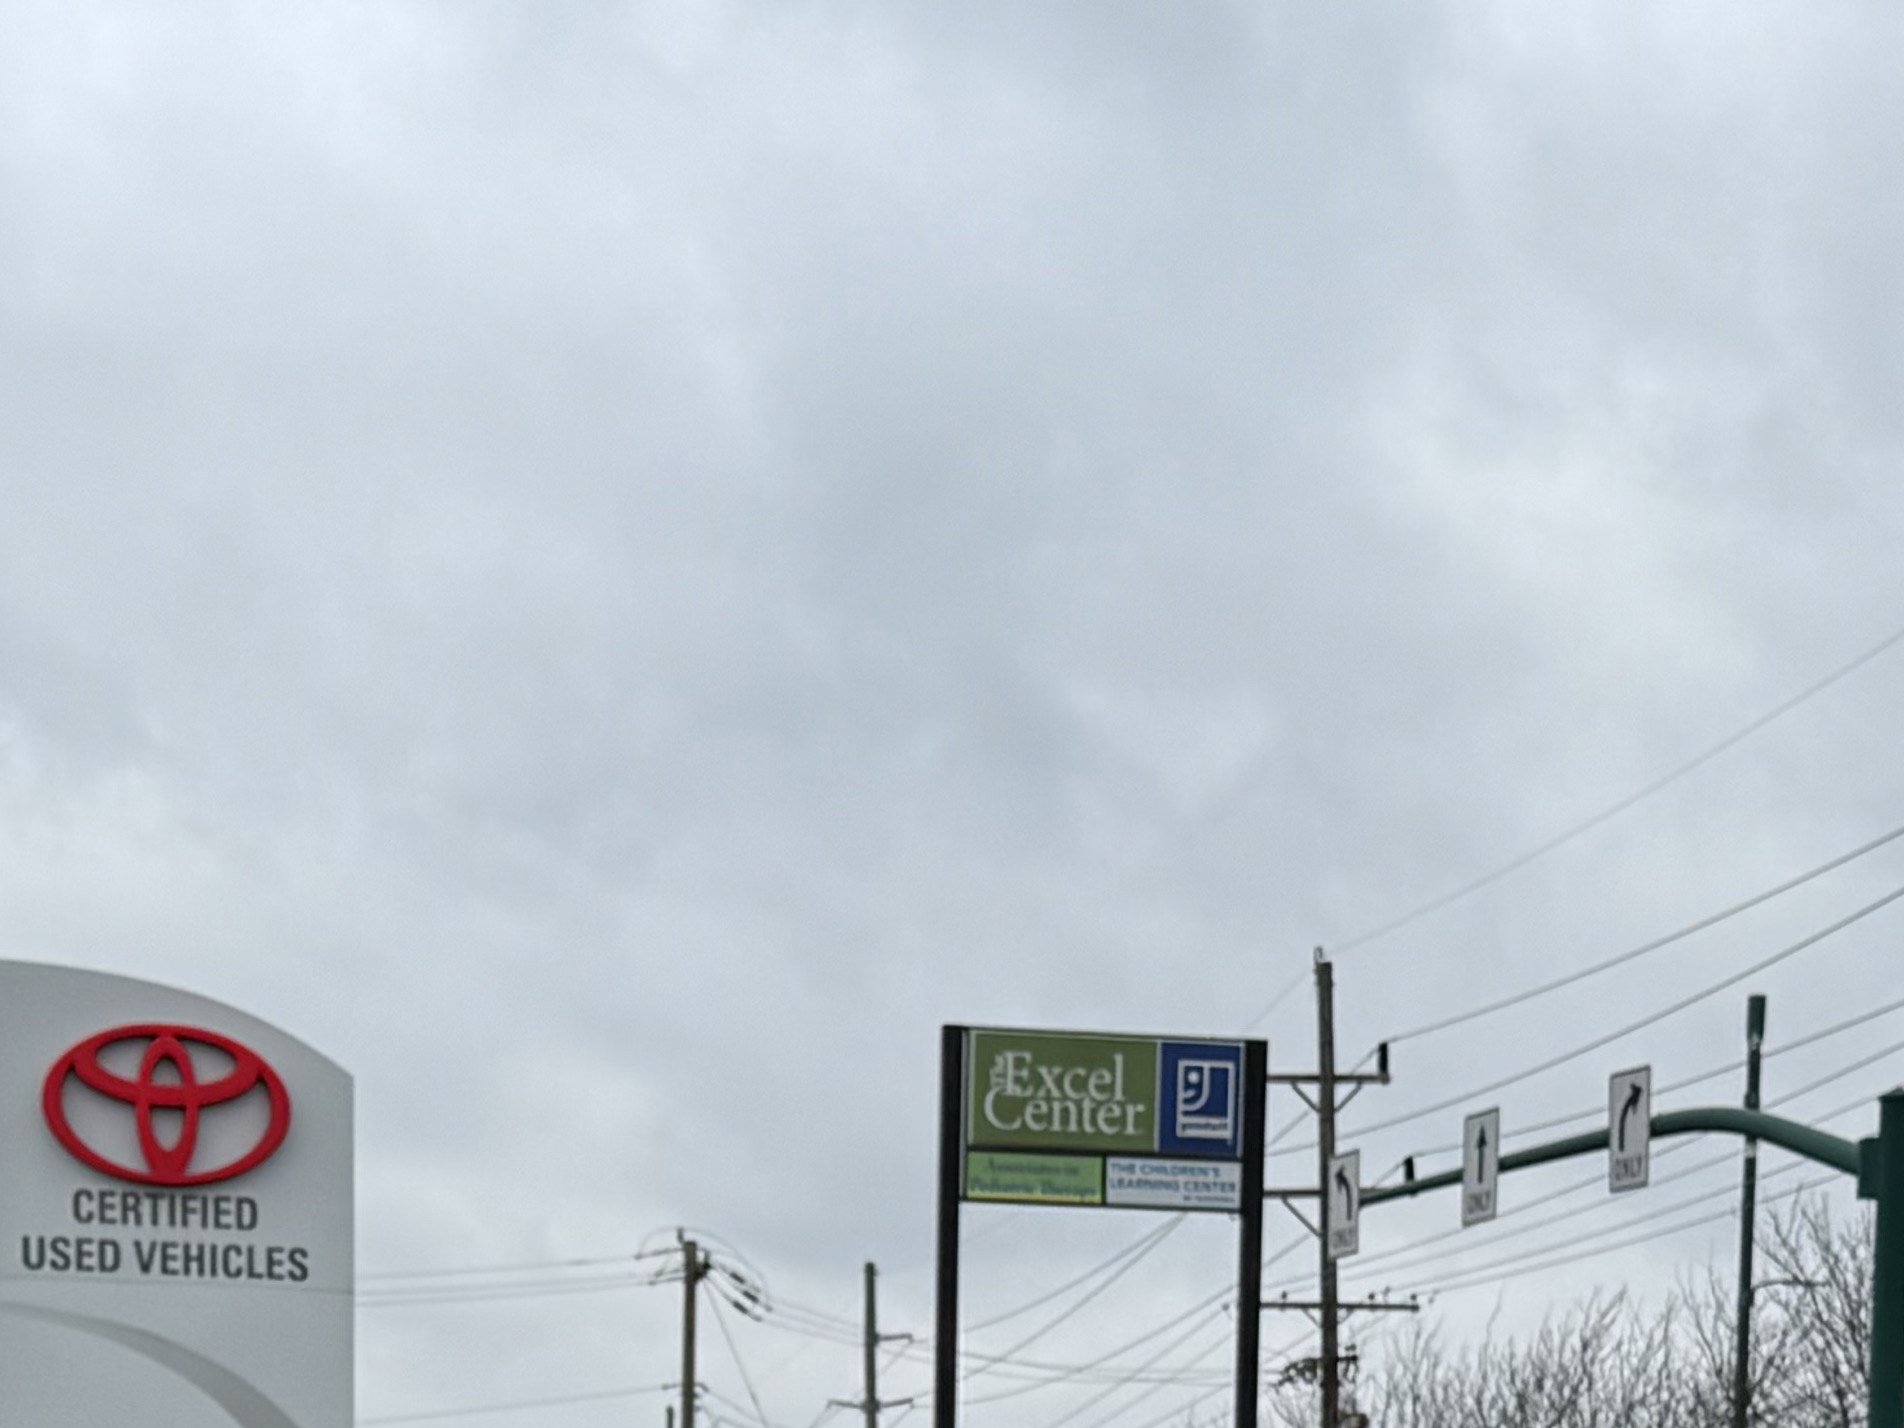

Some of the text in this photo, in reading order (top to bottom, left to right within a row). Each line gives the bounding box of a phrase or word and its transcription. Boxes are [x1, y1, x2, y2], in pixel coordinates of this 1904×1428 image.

[1002, 1050, 1125, 1102] Excel
[984, 1087, 1147, 1136] Center
[1110, 1162, 1137, 1176] THE
[1110, 1177, 1236, 1193] LEARNING CENTER
[71, 1189, 259, 1231] CERTIFIED
[22, 1235, 310, 1283] USED VEHICLES
